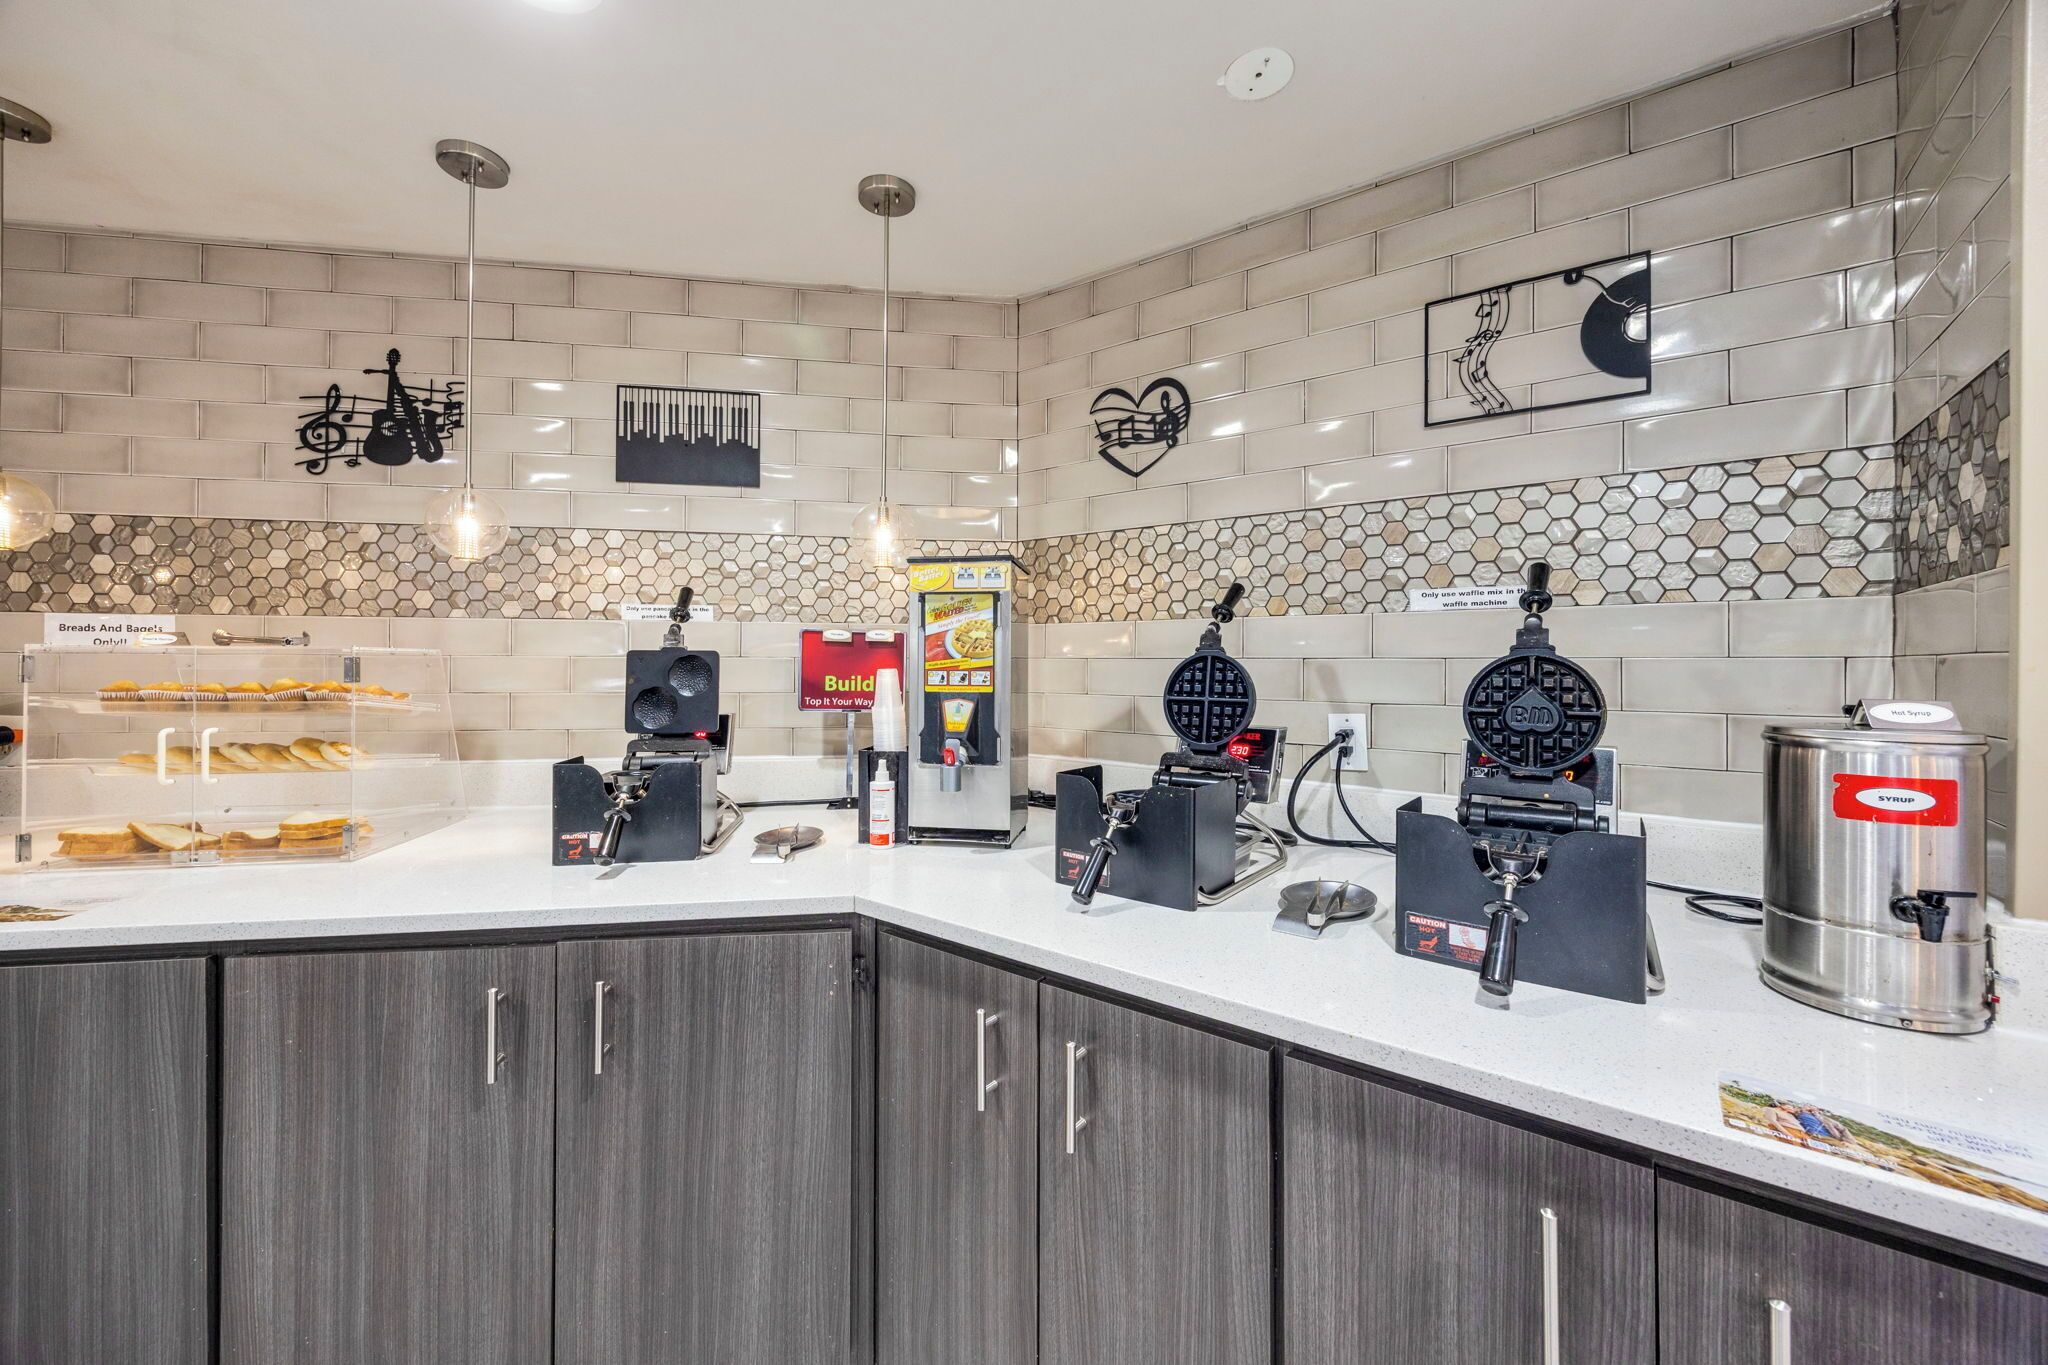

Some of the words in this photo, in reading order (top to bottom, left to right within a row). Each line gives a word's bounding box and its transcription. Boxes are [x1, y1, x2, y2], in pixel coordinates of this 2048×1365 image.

[1421, 592, 1439, 600] Only
[59, 623, 96, 632] Breads
[99, 624, 122, 633] And
[824, 675, 875, 692] Build
[804, 697, 822, 707] Top
[823, 697, 831, 705] It
[832, 698, 852, 706] Your
[854, 698, 873, 707] Way
[1231, 745, 1249, 755] 230
[1878, 795, 1915, 803] SYRUP
[1062, 851, 1085, 860] CAUTION
[1409, 915, 1447, 929] CAUTION
[1419, 926, 1436, 934] HOT
